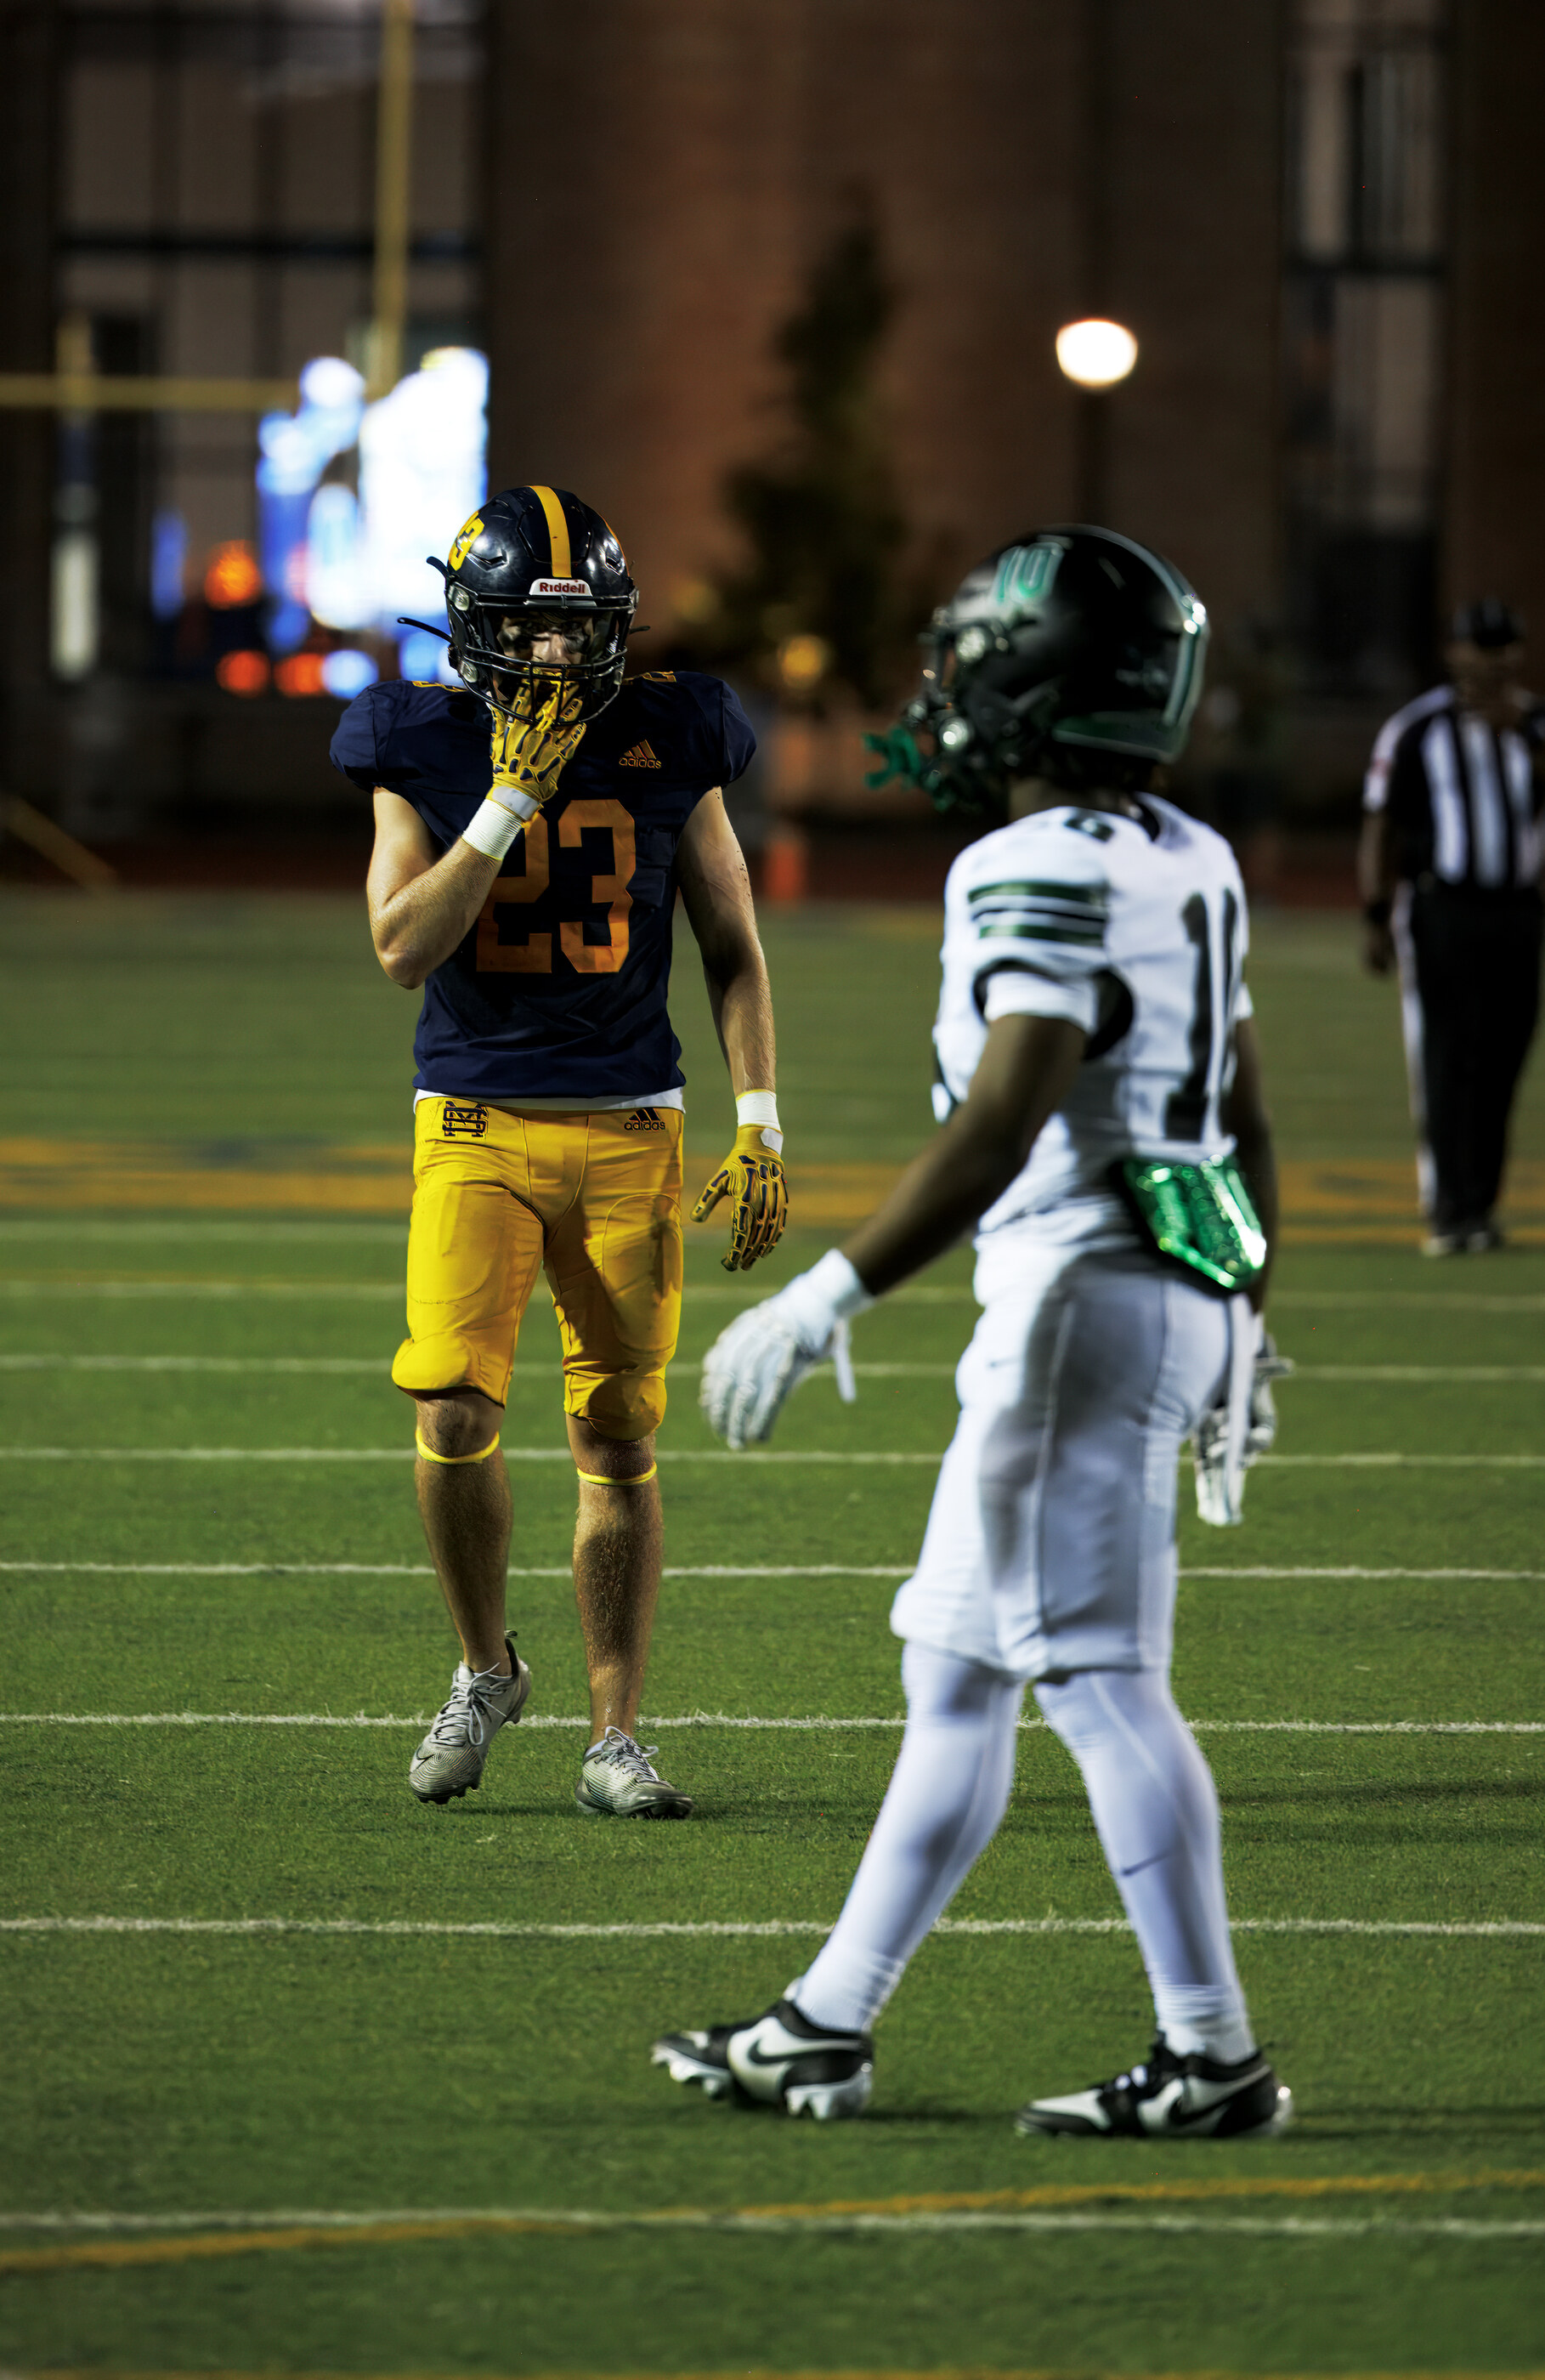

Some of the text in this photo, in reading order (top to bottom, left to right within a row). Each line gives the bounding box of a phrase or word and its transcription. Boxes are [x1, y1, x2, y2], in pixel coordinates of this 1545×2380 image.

[539, 582, 586, 594] Riddell
[619, 756, 661, 769] adidas
[476, 799, 636, 973] 23
[624, 1121, 665, 1130] adidas
